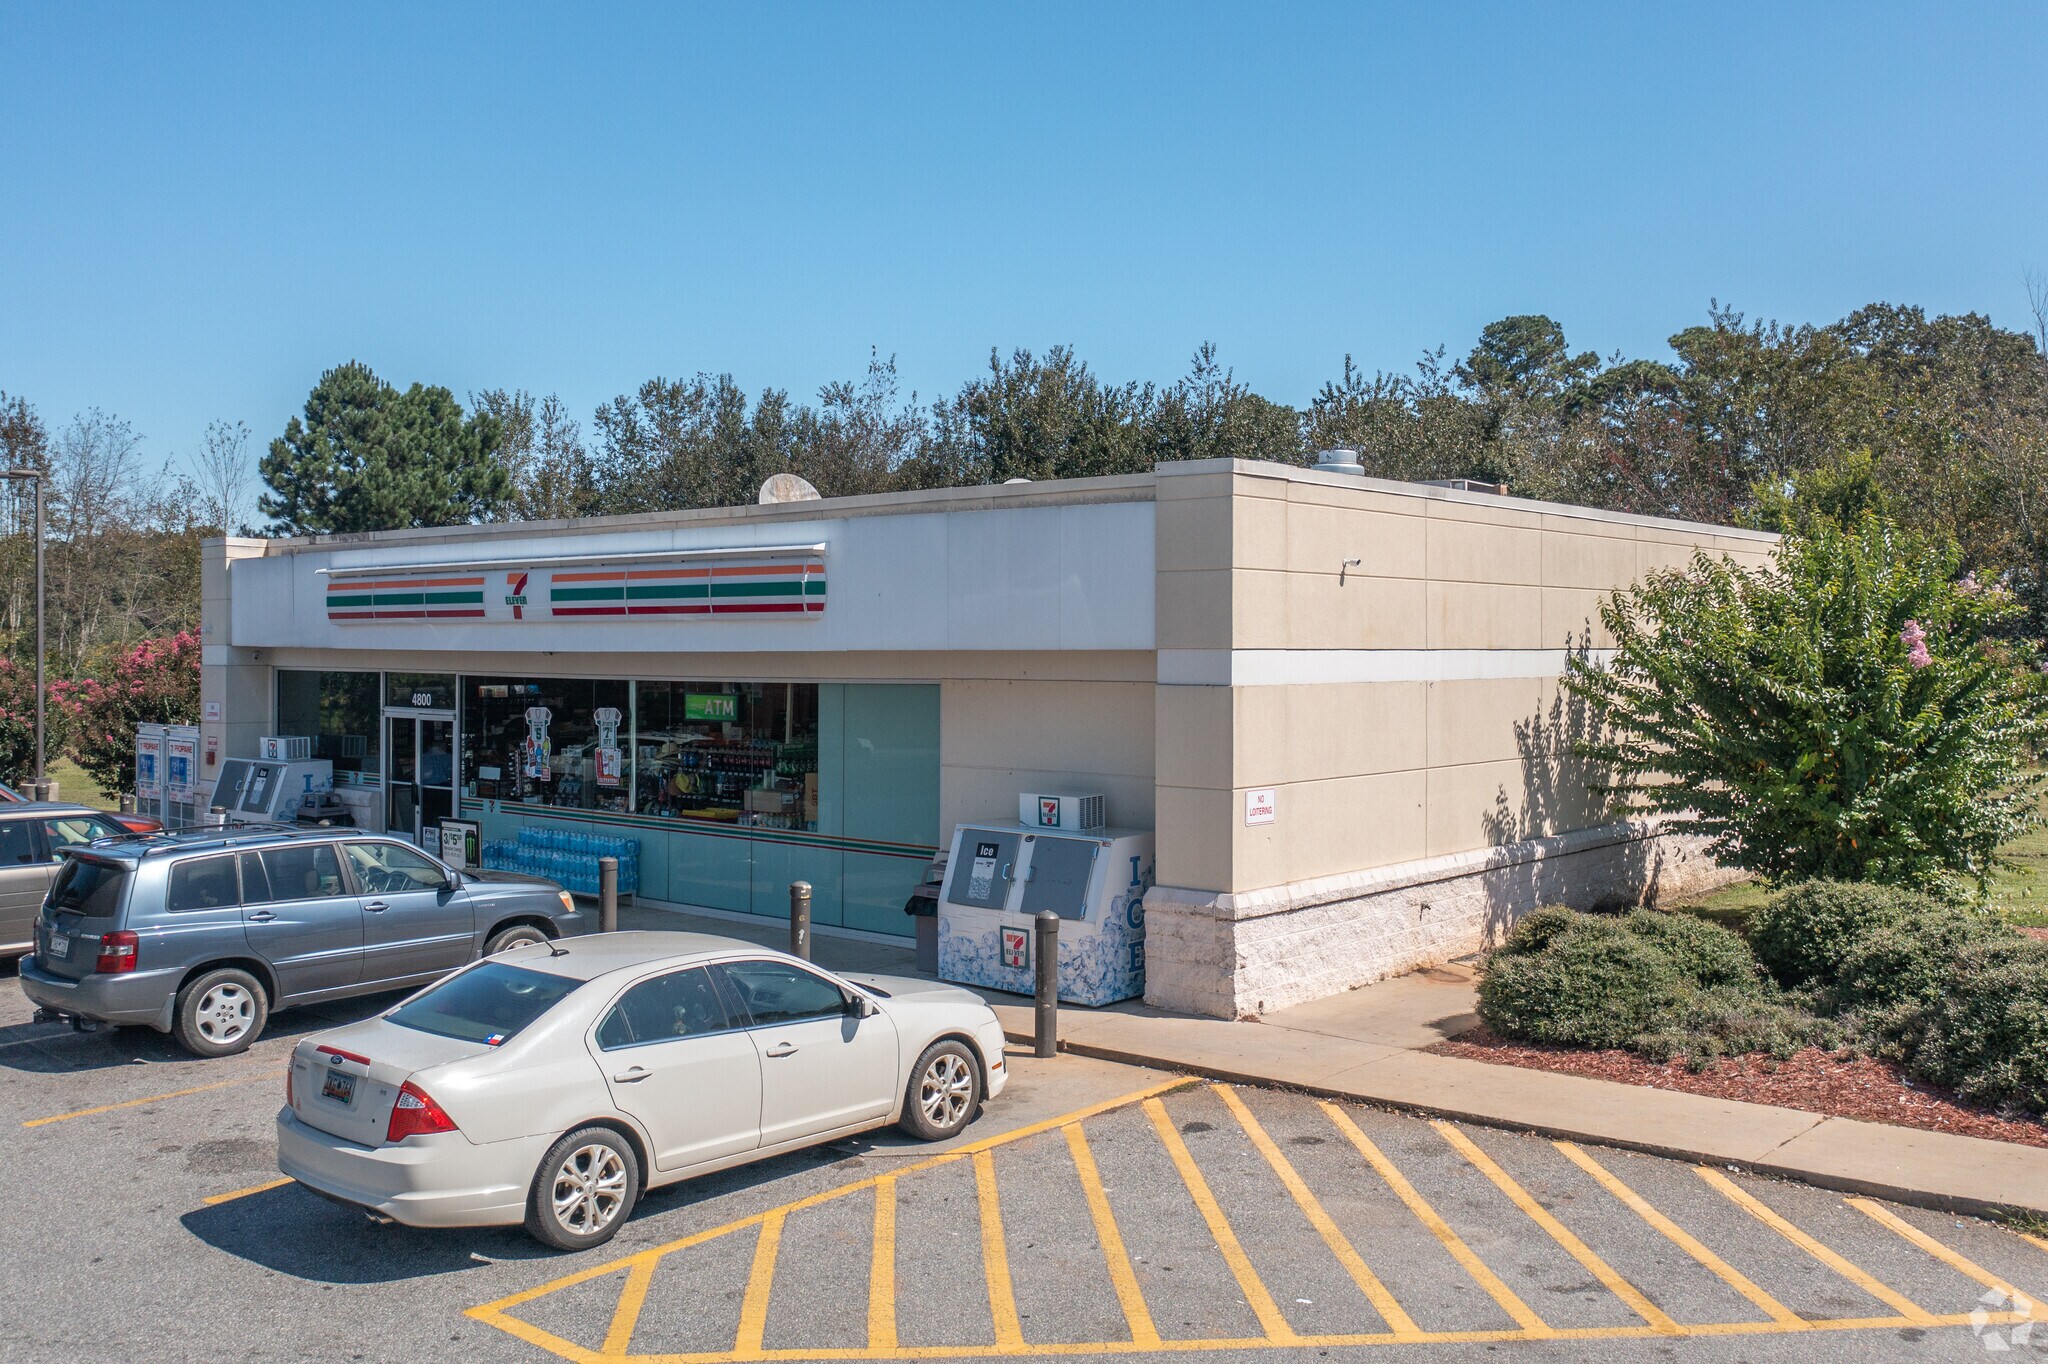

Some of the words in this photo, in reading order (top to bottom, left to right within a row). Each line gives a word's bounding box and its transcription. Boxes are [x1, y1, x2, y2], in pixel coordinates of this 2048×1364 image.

[505, 596, 528, 605] ELEVEN
[506, 572, 528, 620] 7
[412, 693, 432, 706] 4800
[704, 699, 734, 717] ATM
[1257, 794, 1265, 803] NO
[1043, 801, 1056, 825] 7
[1249, 806, 1273, 817] LOITERING
[980, 845, 994, 856] Ice
[1126, 855, 1146, 973] ICE
[1006, 933, 1024, 966] 7
[1006, 948, 1025, 957] ELEVEN
